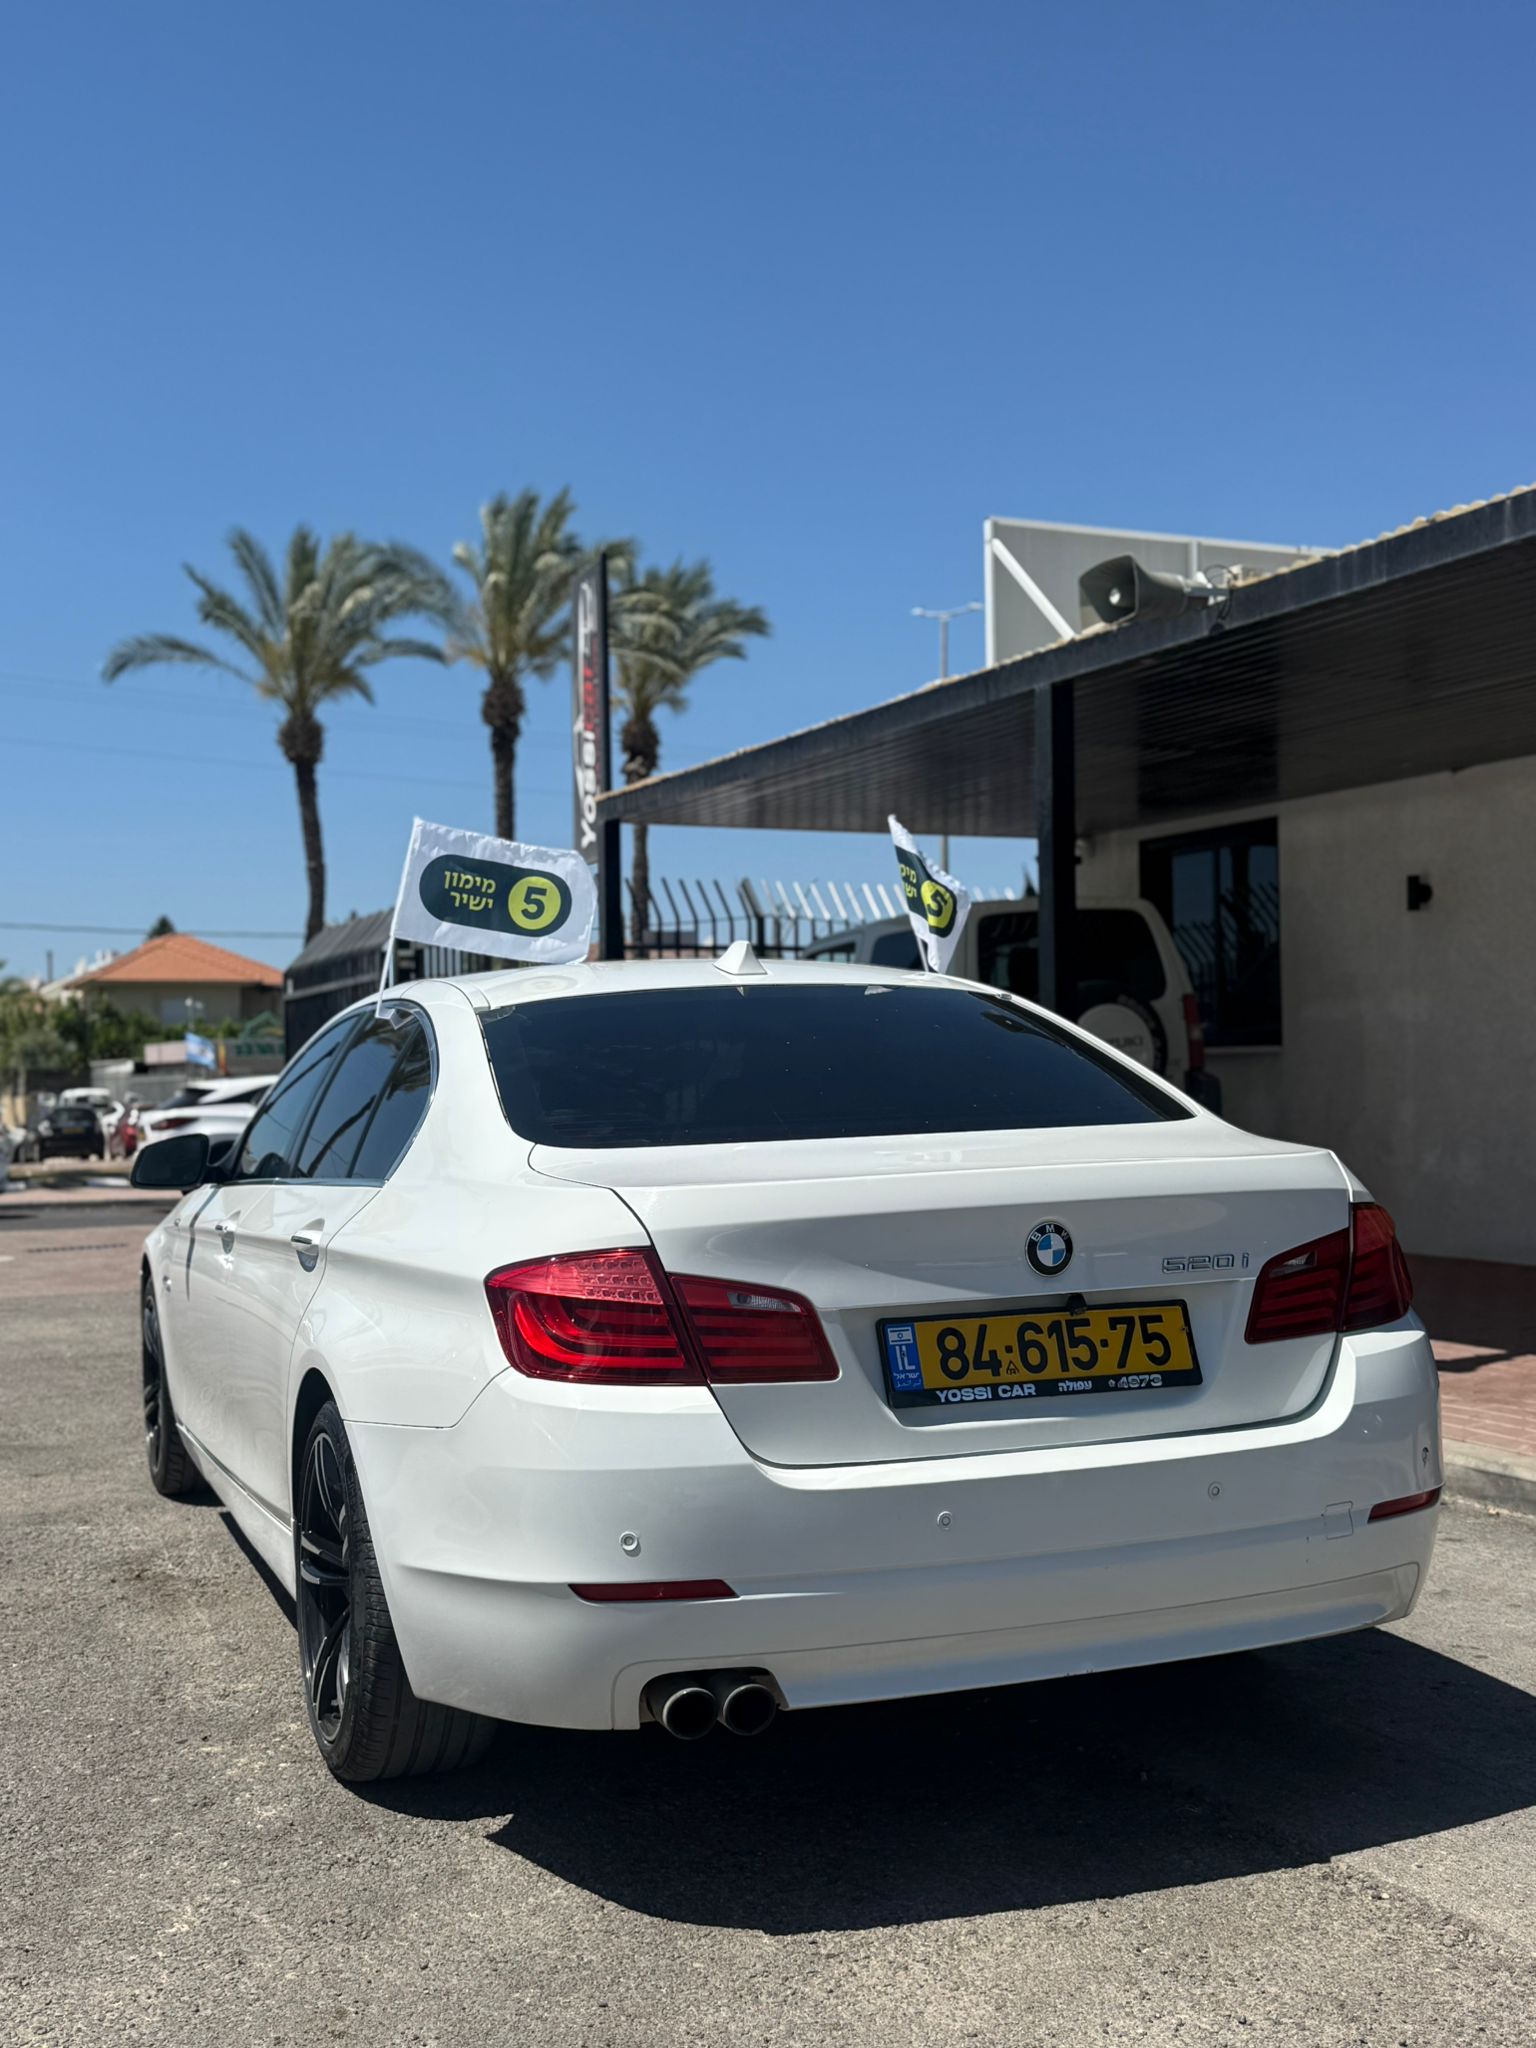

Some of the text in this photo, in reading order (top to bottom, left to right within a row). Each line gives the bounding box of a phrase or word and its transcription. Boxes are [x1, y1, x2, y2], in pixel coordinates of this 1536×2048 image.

[444, 870, 496, 893] מימון
[450, 891, 495, 911] ישיר
[521, 886, 548, 920] 5
[927, 889, 948, 918] 5
[1030, 1224, 1070, 1242] BMW
[1162, 1252, 1250, 1274] 520i
[895, 1345, 916, 1371] IL
[936, 1383, 1036, 1403] YOSSI CAR
[1058, 1379, 1092, 1392] עפולה
